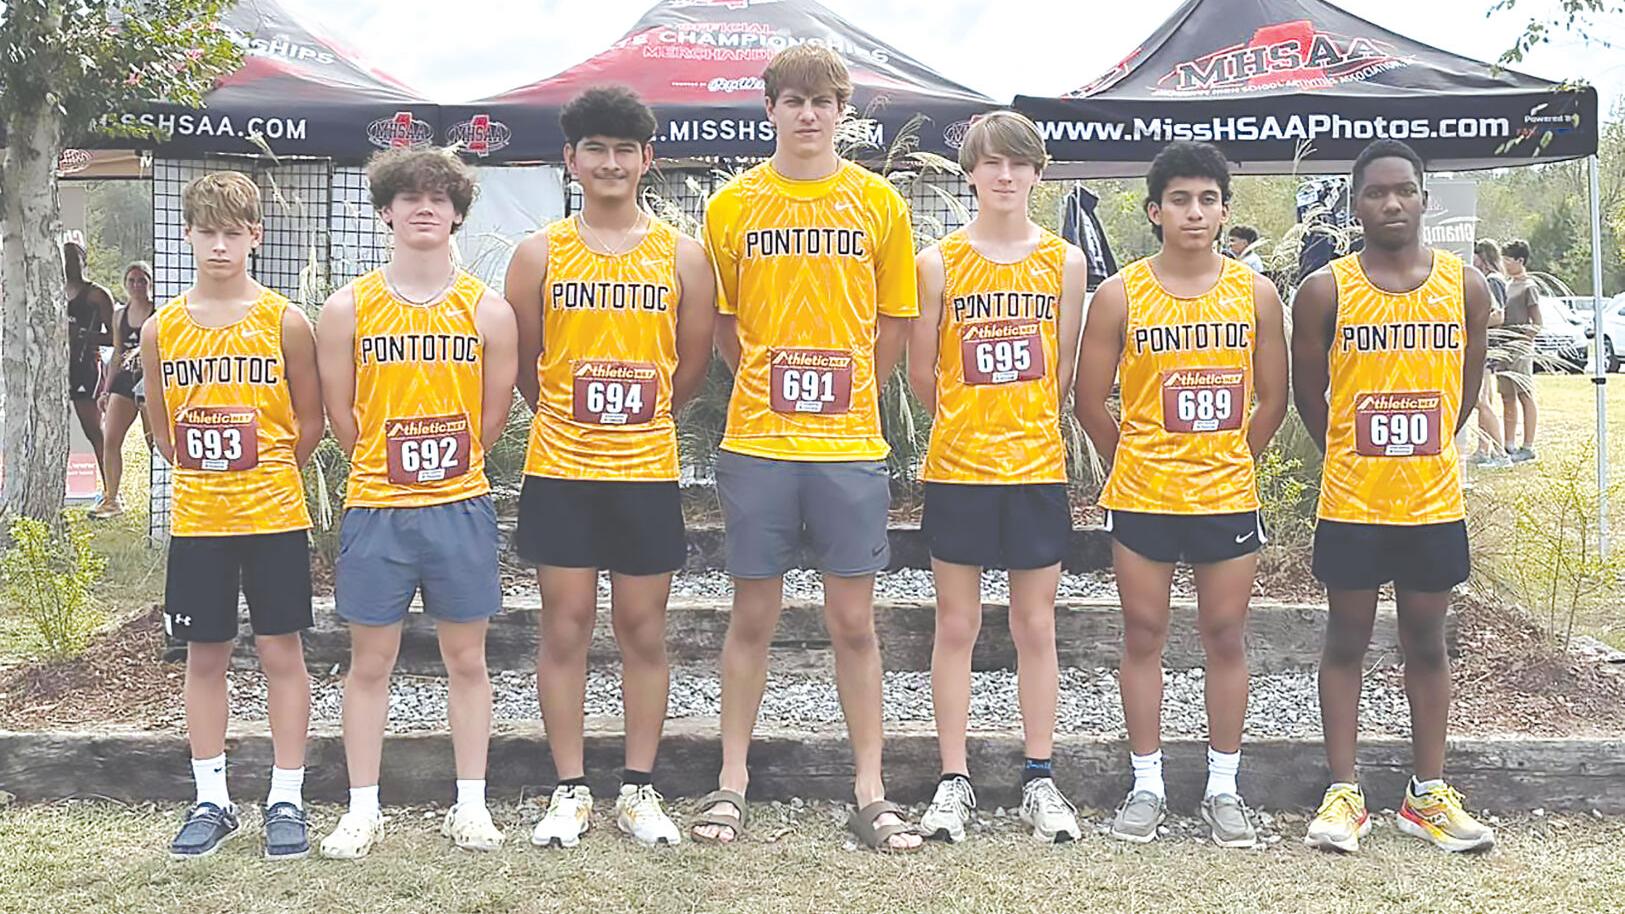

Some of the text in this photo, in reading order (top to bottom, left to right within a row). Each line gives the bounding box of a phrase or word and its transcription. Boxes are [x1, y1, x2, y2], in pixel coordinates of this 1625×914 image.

[643, 45, 775, 61] MERCHANDI
[1176, 33, 1390, 91] MHSAA
[1036, 114, 1509, 142] www.MissHSAAPhotos.com
[1524, 114, 1563, 123] Powered
[746, 228, 865, 258] PONTOTOC
[552, 282, 669, 312] PONTOTOC
[953, 292, 1056, 322] PONTOTOC
[963, 325, 1019, 340] Athletic
[1135, 322, 1250, 354] PONTOTOC
[1342, 323, 1460, 352] PONTOTOC
[361, 334, 479, 364] PONTOTOC
[773, 350, 829, 366] Athletic
[976, 339, 1031, 373] 695
[162, 356, 278, 388] PONTOTOC
[575, 363, 634, 379] Athletic
[783, 369, 835, 402] 691
[1164, 372, 1222, 387] Athletic
[587, 381, 643, 414] 694
[1177, 388, 1232, 421] 689
[1357, 396, 1418, 410] Athletic
[175, 408, 230, 424] Athletic
[388, 421, 447, 437] Athletic
[1370, 413, 1428, 446] 690
[187, 428, 242, 460] 693
[401, 436, 459, 472] 692
